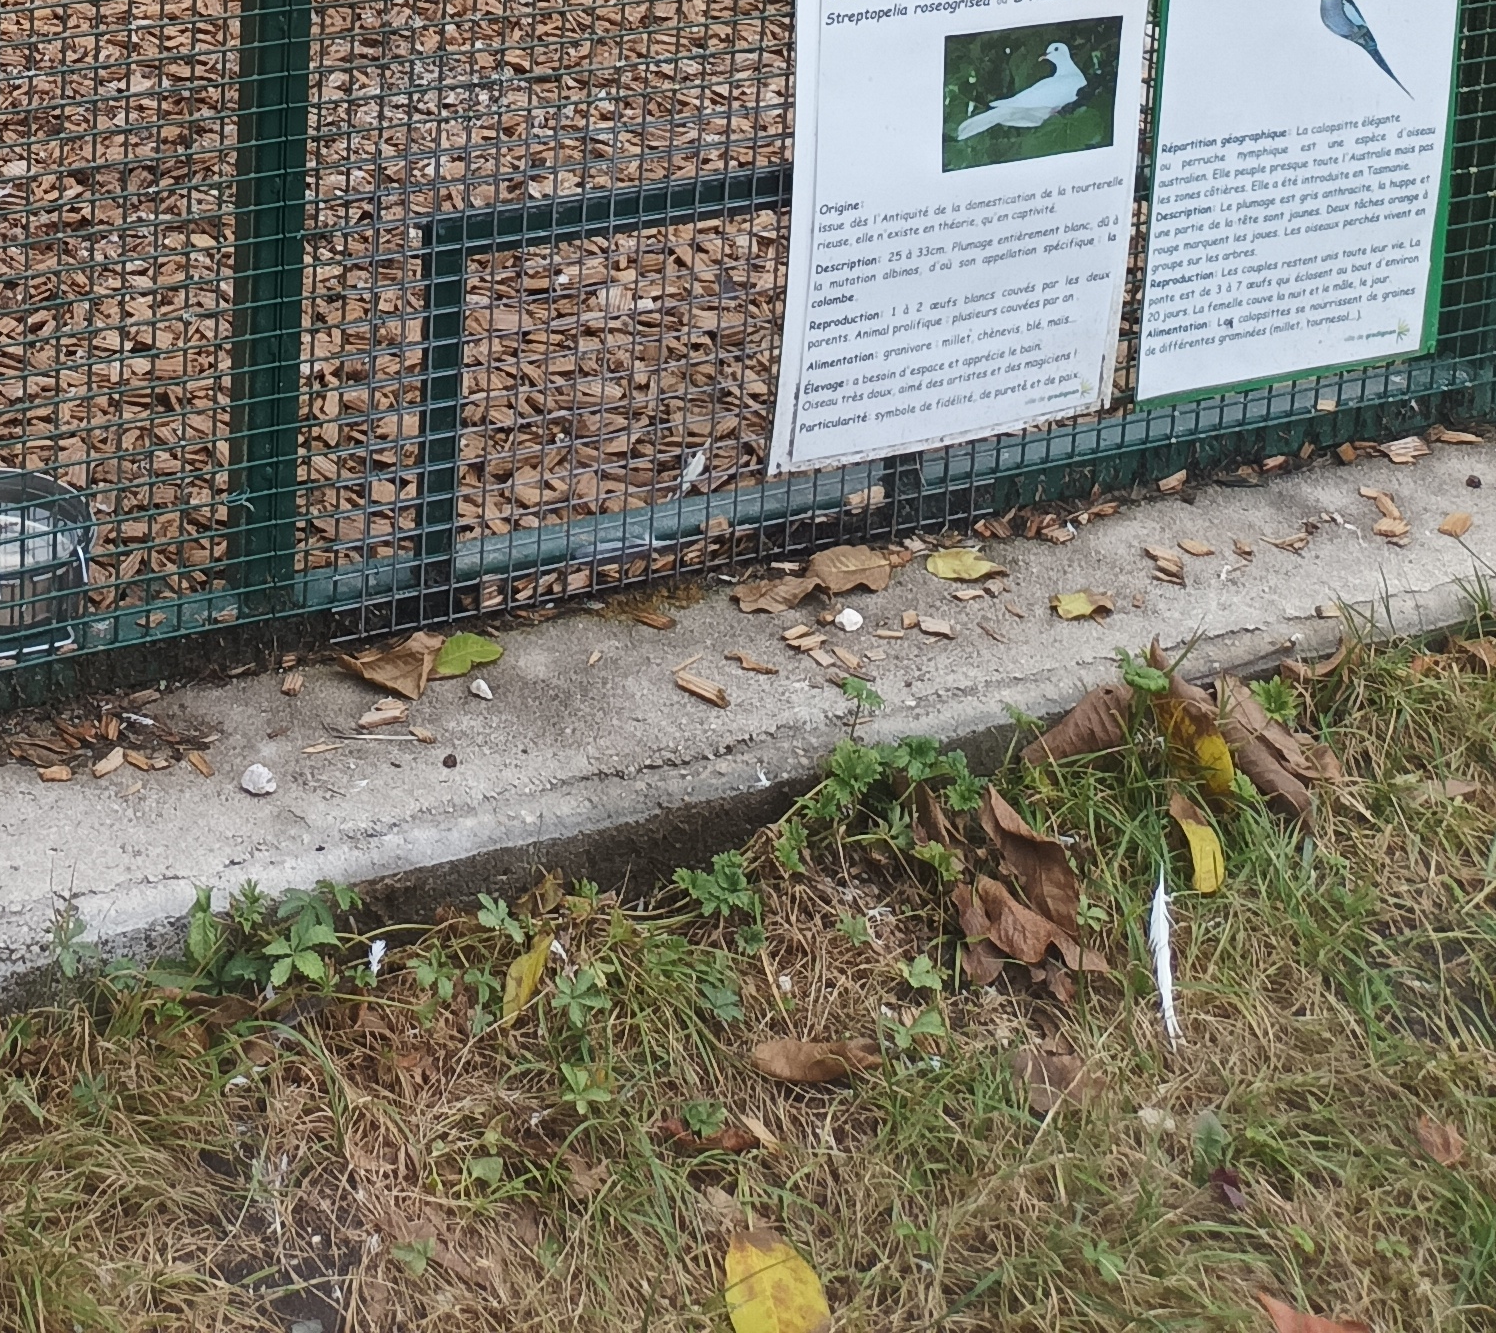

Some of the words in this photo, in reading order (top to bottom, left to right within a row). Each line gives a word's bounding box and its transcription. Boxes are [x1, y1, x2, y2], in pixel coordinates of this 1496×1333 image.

[825, 4, 907, 26] Streptopelia
[1311, 120, 1358, 134] calopsitte
[1181, 153, 1226, 170] perruche
[1237, 146, 1288, 161] nymphique
[1300, 141, 1317, 152] est
[1327, 139, 1344, 149] une
[1212, 168, 1231, 180] Elle
[1234, 163, 1266, 179] peuple
[1269, 160, 1308, 174] presque
[1312, 156, 1339, 166] toute
[1394, 144, 1415, 155] mais
[1418, 143, 1434, 154] pas
[818, 222, 844, 233] issue
[965, 193, 1036, 210] domestication
[1071, 176, 1123, 193] tourterelle
[1157, 195, 1171, 205] les
[1174, 190, 1201, 202] zones
[1251, 179, 1269, 192] Elle
[1301, 171, 1349, 184] introduite
[1235, 197, 1276, 212] plumage
[1279, 193, 1296, 204] est
[1299, 190, 1319, 204] gris
[1389, 177, 1416, 189] huppe
[1152, 244, 1179, 256] rouge
[1183, 235, 1229, 250] marquent
[1233, 233, 1247, 242] les
[1283, 226, 1301, 236] Les
[1304, 221, 1340, 233] oiseaux
[1383, 209, 1412, 220] vivent
[1154, 229, 1170, 239] une
[1174, 223, 1204, 238] partie
[1262, 211, 1284, 223] sont
[1326, 203, 1350, 214] Deux
[1387, 193, 1419, 205] orange
[855, 232, 874, 244] elle
[951, 238, 993, 251] Plumage
[829, 274, 876, 288] mutation
[958, 257, 976, 268] son
[981, 247, 1037, 265] appellation
[1151, 260, 1183, 275] groupe
[1186, 256, 1203, 266] sur
[1205, 253, 1219, 263] les
[1221, 267, 1238, 277] Les
[1241, 261, 1278, 274] couples
[1281, 255, 1318, 268] restent
[1320, 251, 1339, 262] unis
[1342, 247, 1367, 258] toute
[1369, 244, 1388, 254] leur
[963, 291, 995, 304] blancs
[1041, 280, 1059, 293] par
[1065, 275, 1079, 285] les
[1086, 271, 1110, 282] deux
[1148, 294, 1175, 308] ponte
[1179, 289, 1195, 300] est
[1275, 277, 1290, 287] qui
[1350, 261, 1372, 273] bout
[1207, 297, 1243, 312] femelle
[1246, 294, 1273, 305] couve
[1287, 288, 1306, 299] nuit
[854, 326, 889, 340] Animal
[891, 317, 942, 336] prolifique
[951, 307, 998, 325] plusieurs
[1042, 296, 1060, 309] par
[1238, 307, 1291, 323] calopsittes
[1309, 294, 1362, 311] nourrissent
[1381, 287, 1415, 302] graines
[883, 342, 932, 361] granivore
[801, 398, 838, 411] Oiseau
[925, 378, 944, 389] des
[946, 369, 987, 385] artistes
[1004, 362, 1022, 373] des
[1023, 352, 1071, 369] magiciens
[862, 370, 896, 384] besoin
[874, 404, 916, 421] symbole
